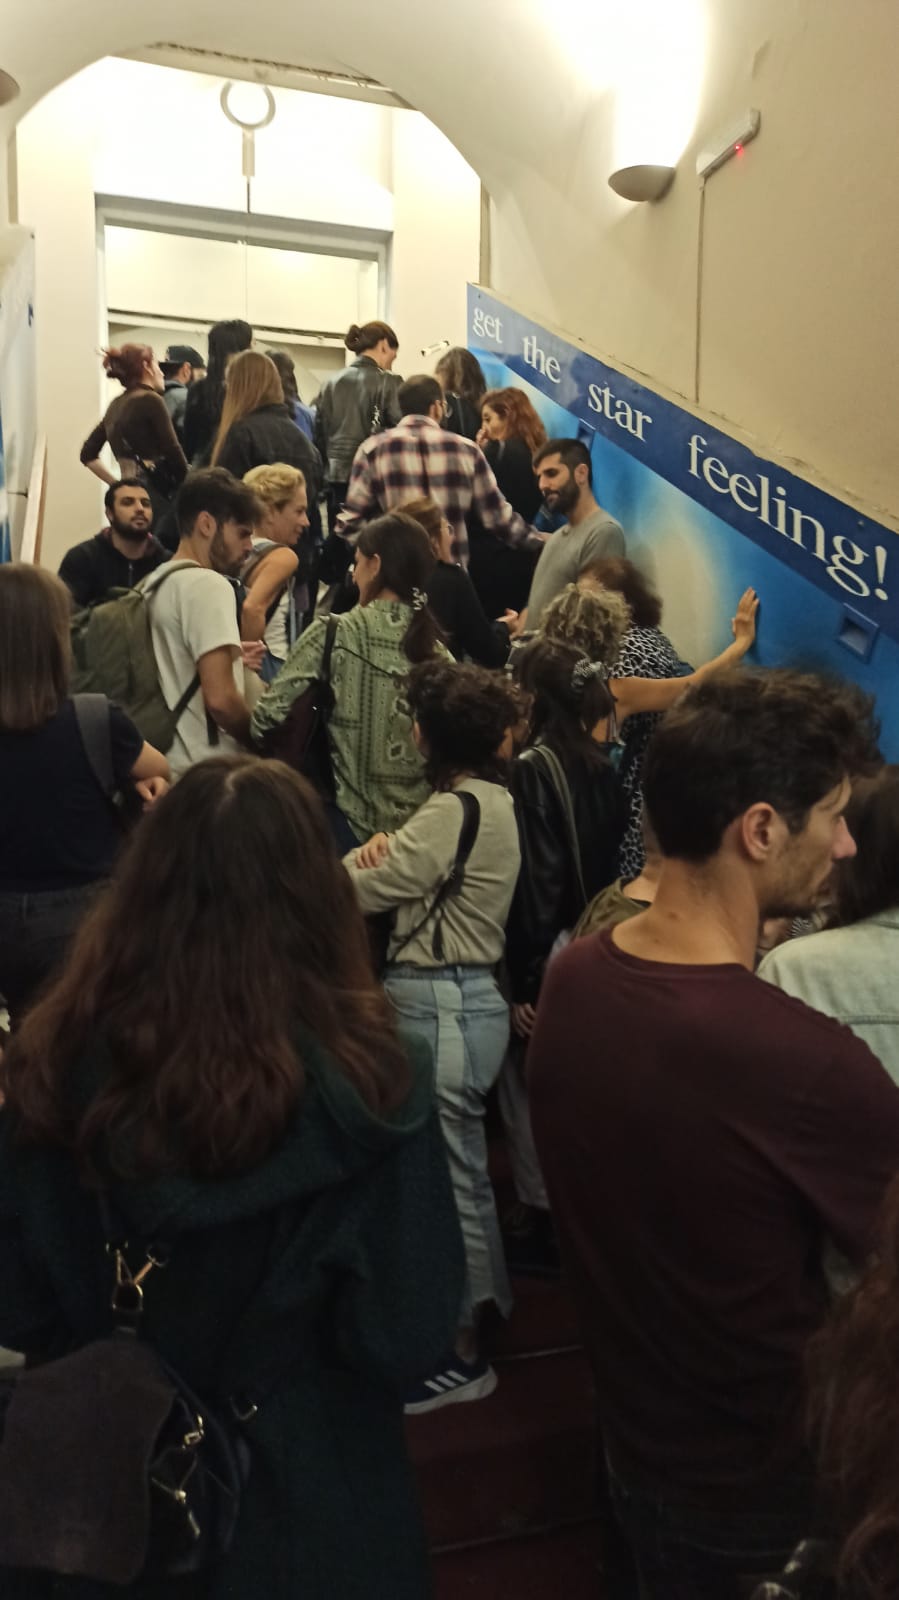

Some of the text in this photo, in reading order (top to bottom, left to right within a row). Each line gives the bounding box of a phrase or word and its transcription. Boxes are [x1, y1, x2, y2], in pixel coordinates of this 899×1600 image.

[473, 306, 889, 601] get the star feeling!
